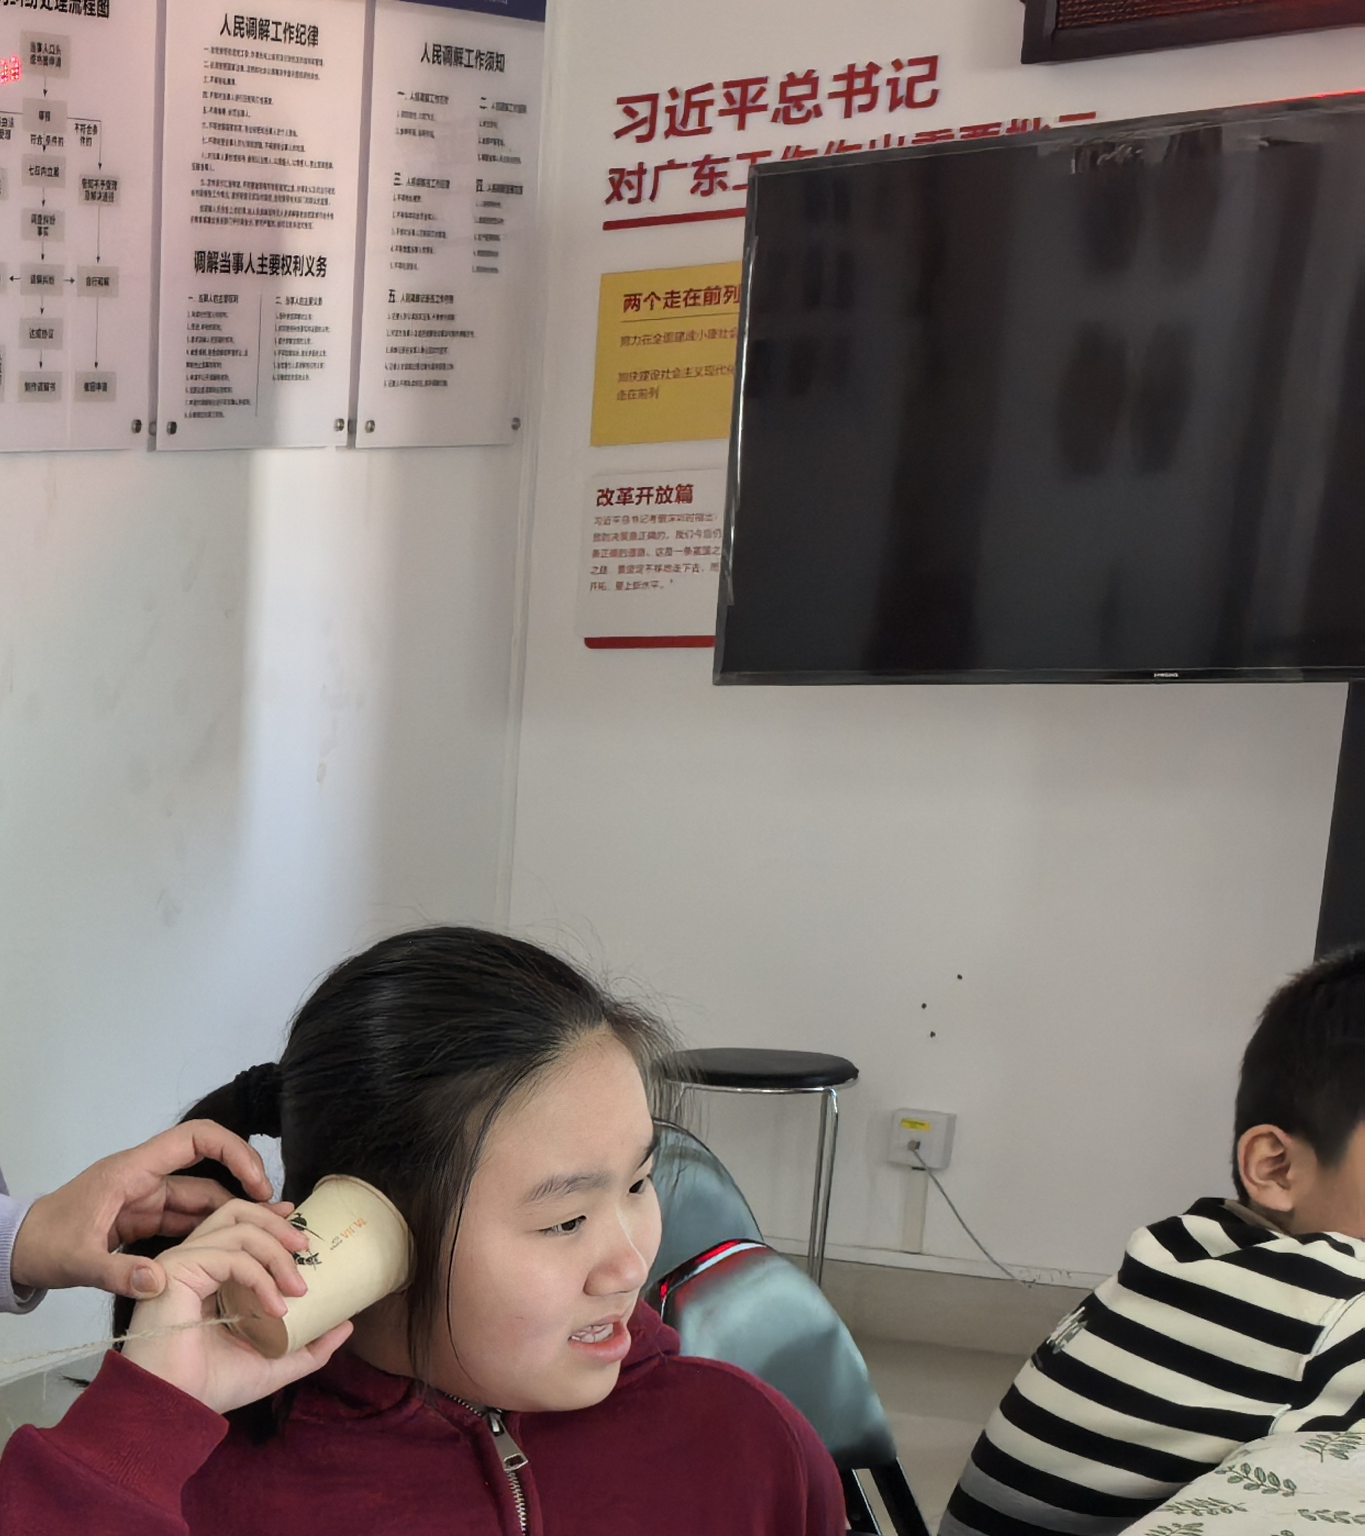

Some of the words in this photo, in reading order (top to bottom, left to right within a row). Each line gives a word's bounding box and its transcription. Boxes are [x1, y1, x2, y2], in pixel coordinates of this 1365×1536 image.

[220, 13, 319, 47] 人民调解工作纪律
[420, 42, 505, 72] 人民调解工作须知
[613, 55, 940, 144] 习近平总书记
[194, 250, 327, 278] 调解当事人主要权利义务
[623, 285, 741, 313] 两个走在前列
[596, 484, 694, 507] 改革开放篇
